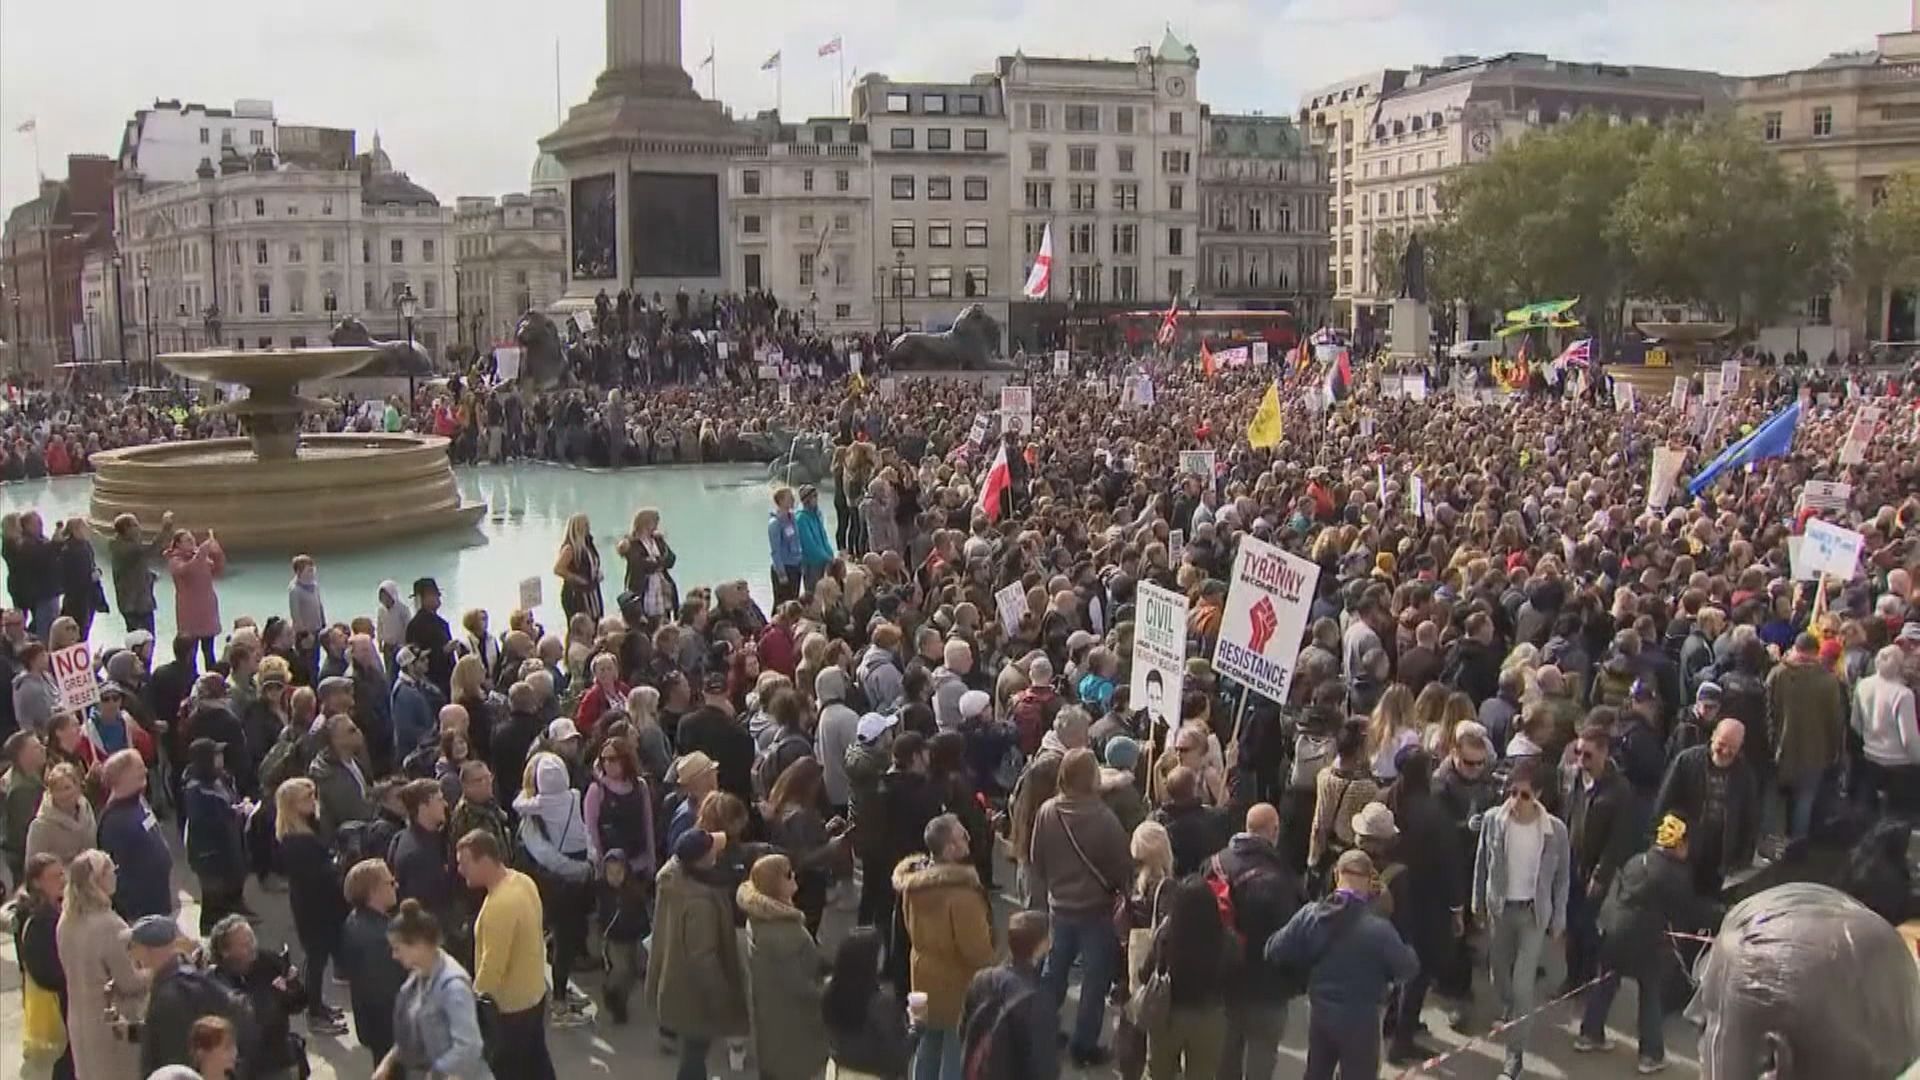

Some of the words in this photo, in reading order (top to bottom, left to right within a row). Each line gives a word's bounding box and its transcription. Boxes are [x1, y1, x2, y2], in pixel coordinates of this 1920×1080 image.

[1240, 574, 1279, 595] BECOMES
[1244, 550, 1305, 595] TYRANNY
[1146, 598, 1174, 633] CIVIL
[56, 648, 89, 677] NO
[1218, 639, 1288, 687] RESISTANCE
[64, 672, 91, 691] GREAT
[1216, 660, 1256, 685] BECOMES
[1257, 681, 1282, 698] DUTY
[69, 688, 95, 704] RESET
